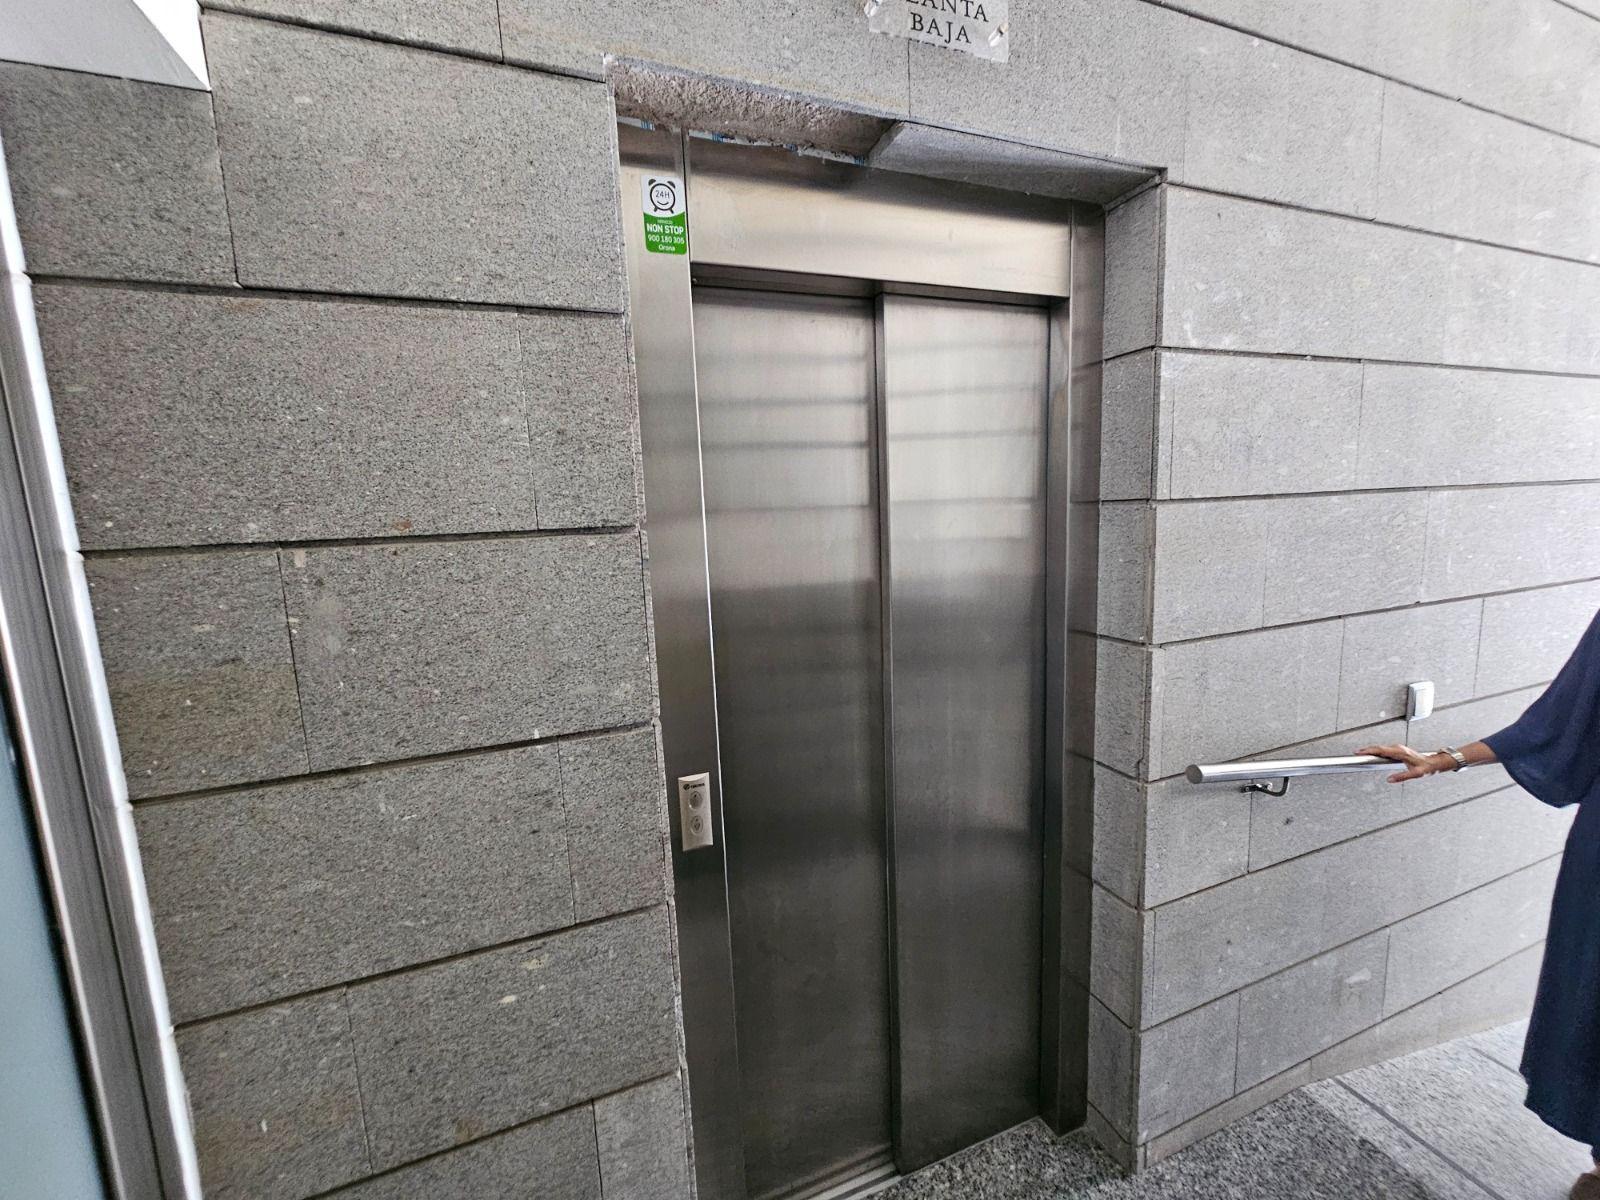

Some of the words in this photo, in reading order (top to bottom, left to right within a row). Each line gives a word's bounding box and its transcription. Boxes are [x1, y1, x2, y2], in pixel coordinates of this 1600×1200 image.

[905, 0, 989, 22] ANTA
[910, 12, 972, 44] BAJA
[655, 190, 670, 198] 24H
[646, 223, 663, 233] NON
[664, 225, 684, 234] STOP
